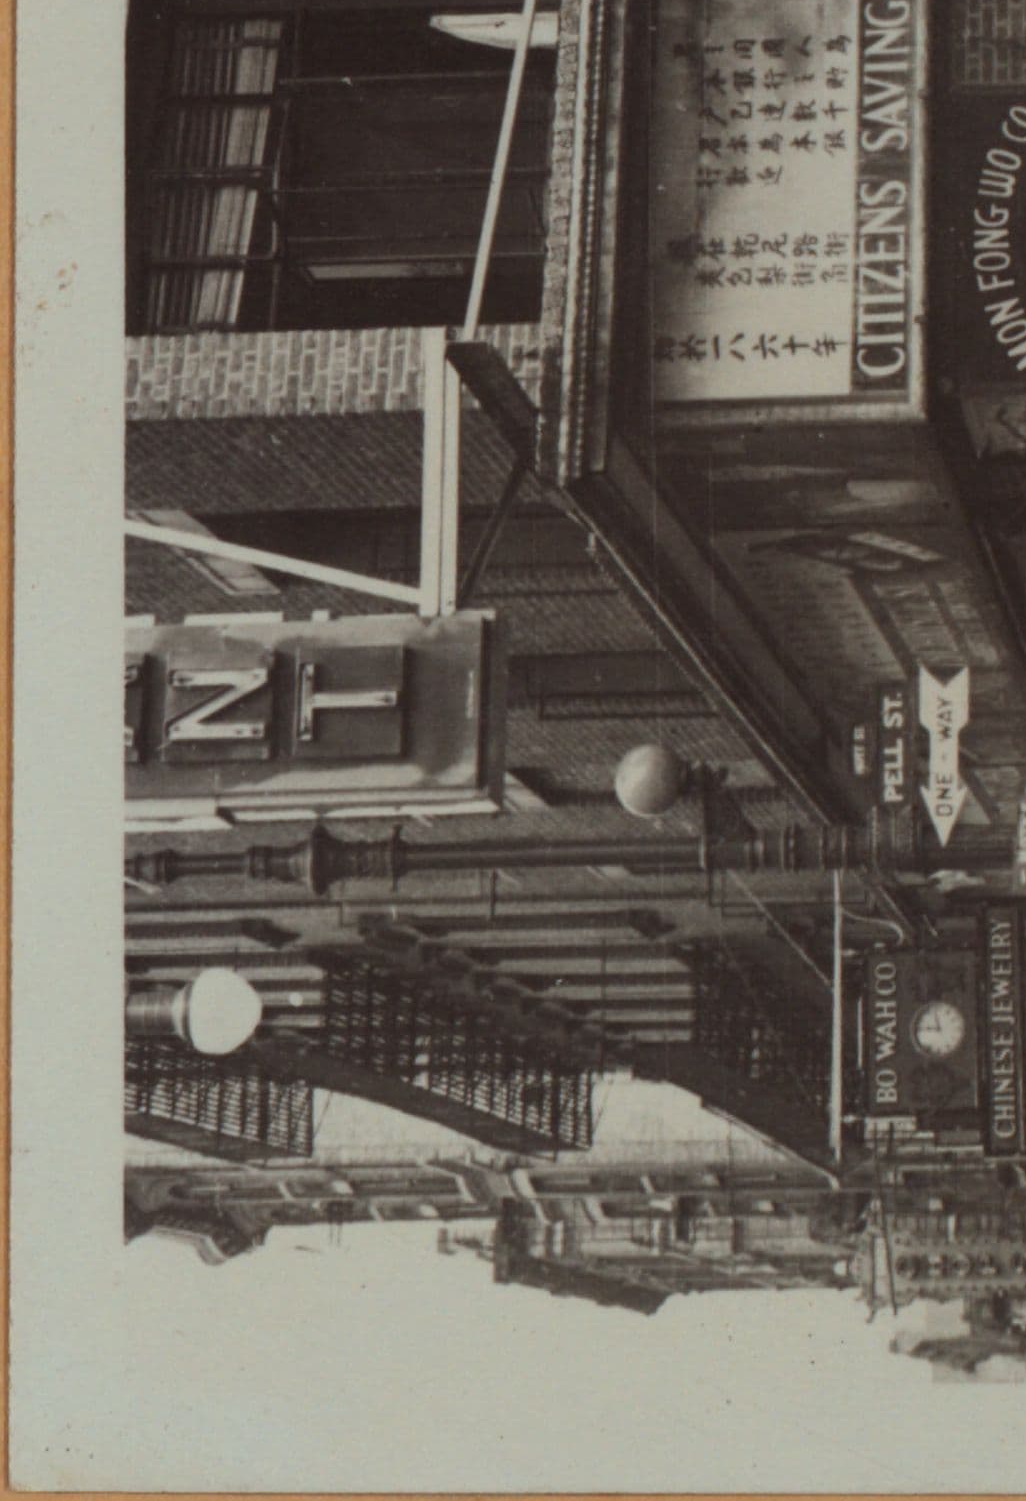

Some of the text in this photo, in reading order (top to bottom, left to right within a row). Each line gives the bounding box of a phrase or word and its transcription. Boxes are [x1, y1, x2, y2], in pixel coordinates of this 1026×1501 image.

[979, 146, 1024, 199] WO
[856, 179, 909, 378] CITIZENS
[971, 202, 1017, 292] FONG
[122, 662, 399, 748] NT
[881, 690, 905, 803] PELL ST.
[935, 696, 954, 742] WAY
[935, 771, 955, 818] ONE
[874, 960, 899, 1105] BO WAH CO
[989, 916, 1018, 1139] CHINESE JEWELRY
